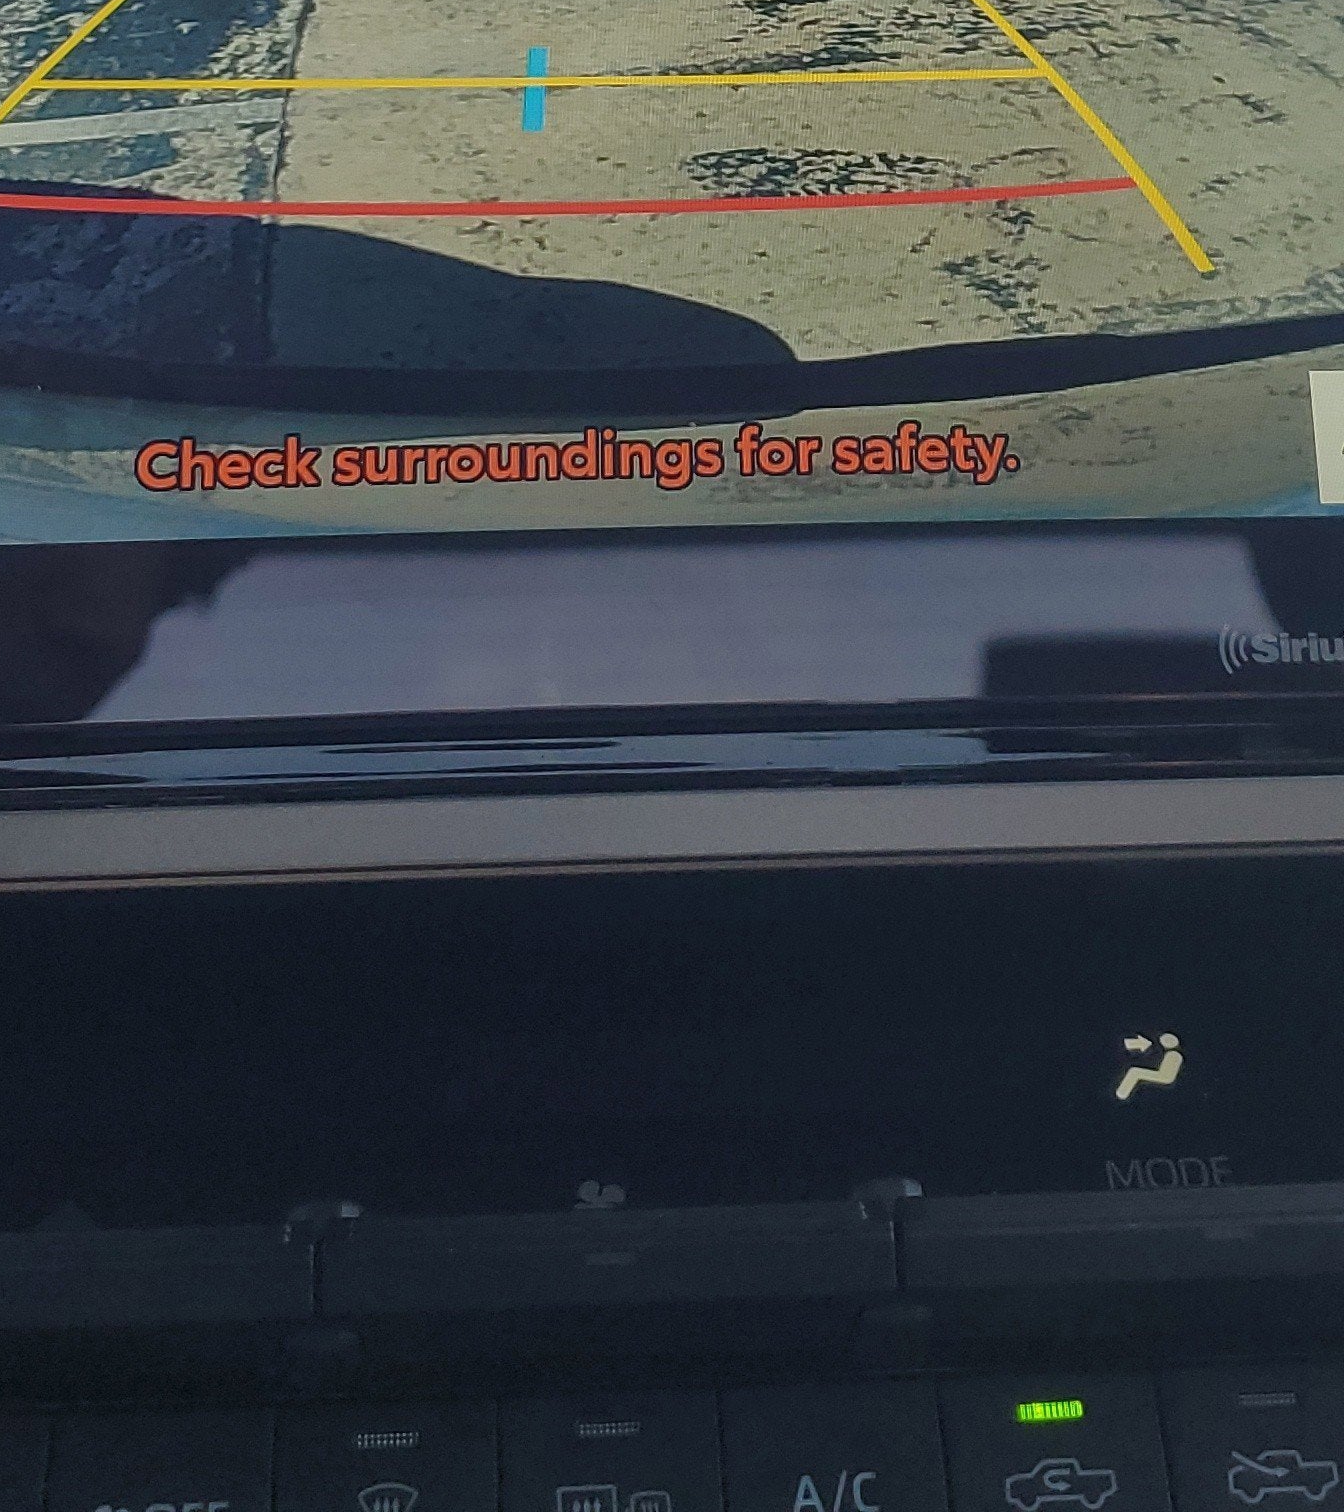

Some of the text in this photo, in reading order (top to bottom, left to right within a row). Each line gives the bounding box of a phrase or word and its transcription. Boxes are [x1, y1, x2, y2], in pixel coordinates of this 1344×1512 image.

[136, 422, 1018, 490] Check surroundings for safety.
[1105, 1155, 1234, 1190] MODE
[793, 1469, 880, 1512] A/C
